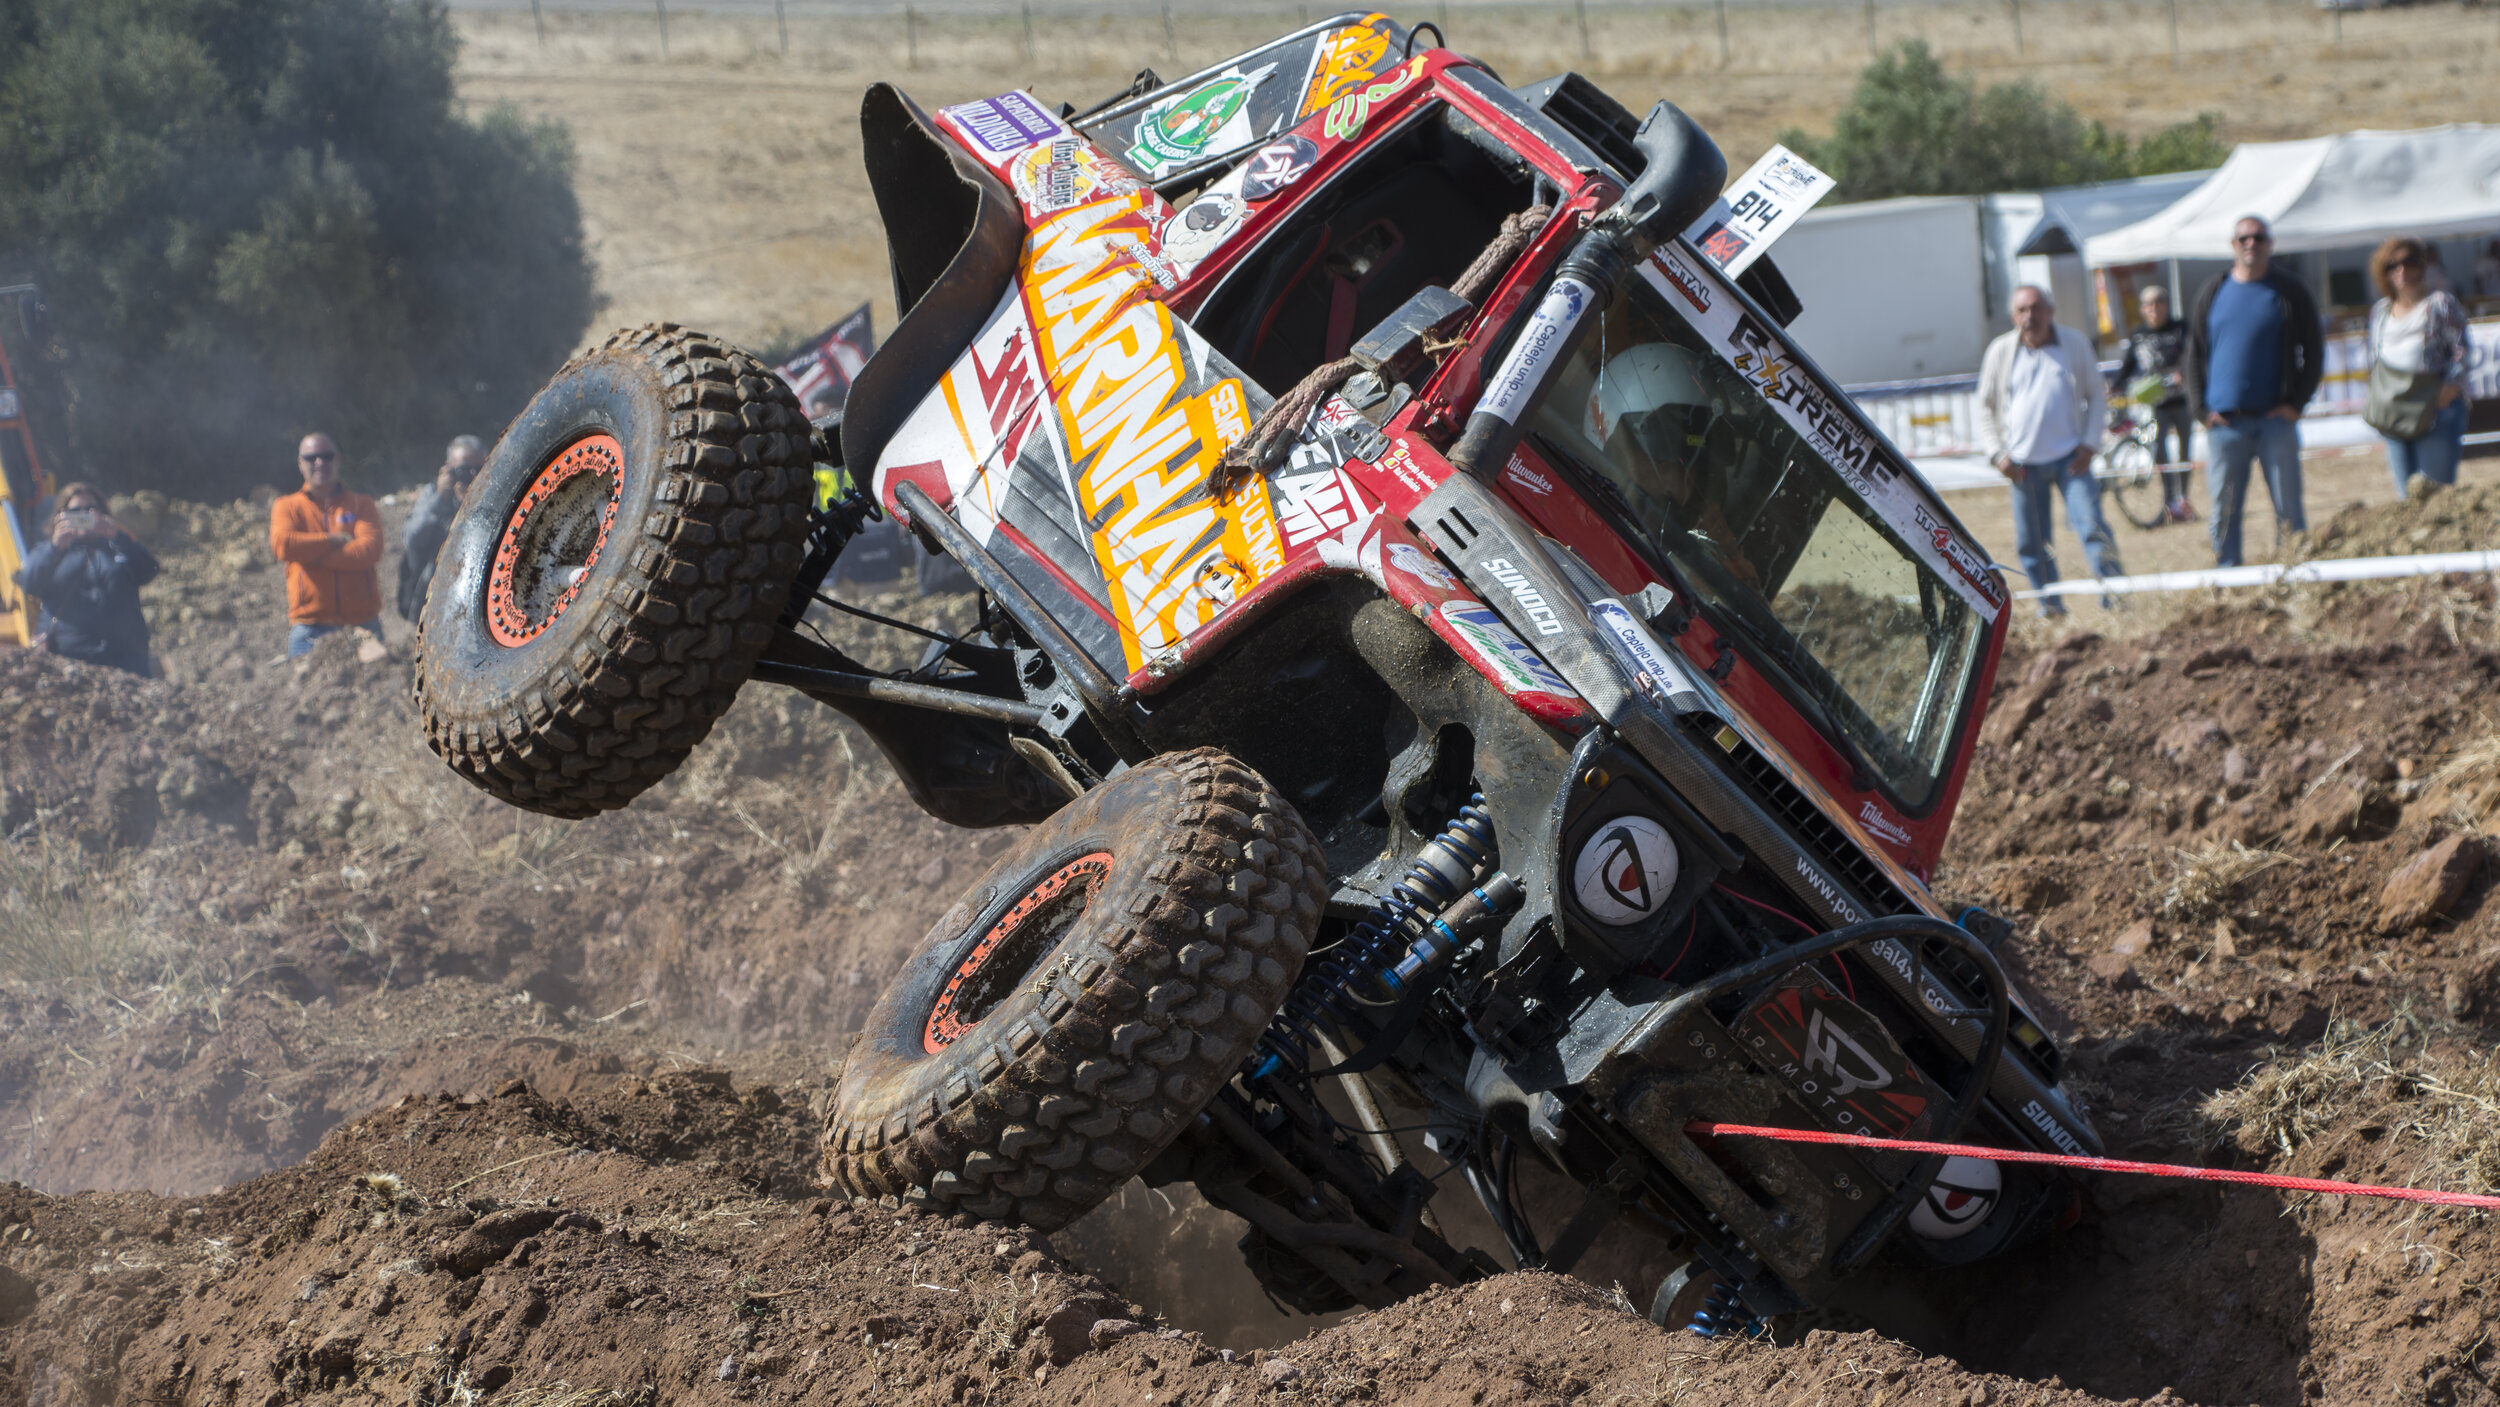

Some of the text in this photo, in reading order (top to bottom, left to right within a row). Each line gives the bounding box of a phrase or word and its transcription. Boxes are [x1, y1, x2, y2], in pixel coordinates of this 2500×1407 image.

[993, 94, 1053, 136] SAPATARIA
[1053, 138, 1083, 206] Vitor Oliveira
[1731, 189, 1782, 232] 814
[1524, 324, 1557, 367] Captejo
[1208, 383, 1248, 452] SEMP
[1801, 377, 1868, 447] TROFEU
[1806, 431, 1873, 497] PROTO
[1479, 557, 1564, 636] SUNOCO
[1621, 628, 1651, 659] Captejo
[1860, 800, 1912, 844] Milwaukee
[1737, 1026, 1886, 1152] HR-MOTOR
